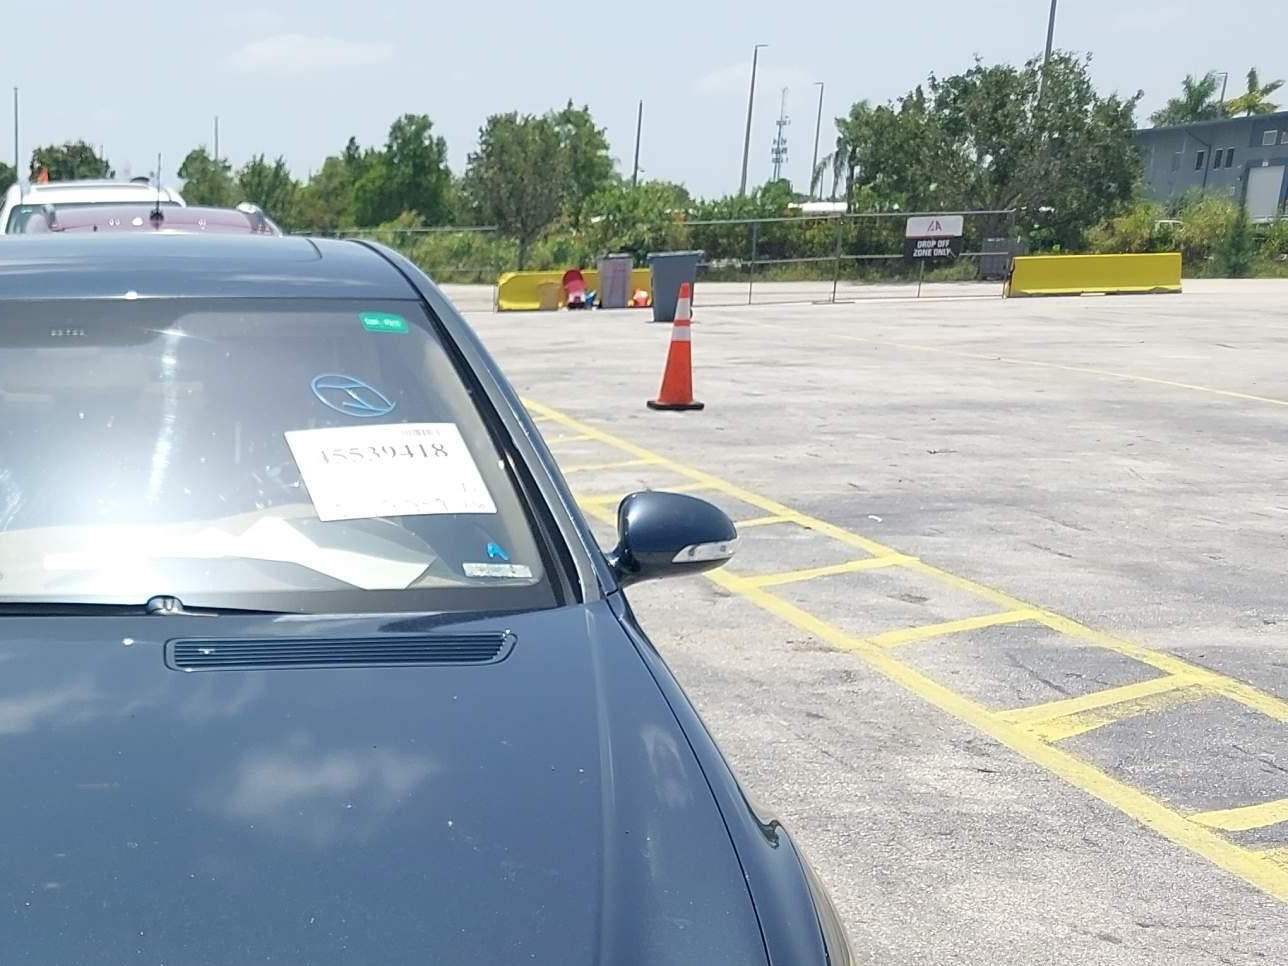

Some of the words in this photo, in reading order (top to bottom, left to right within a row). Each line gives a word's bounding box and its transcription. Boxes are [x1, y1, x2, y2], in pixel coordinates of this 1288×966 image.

[917, 240, 937, 248] DROP
[937, 240, 950, 248] OFF
[913, 249, 933, 257] ZONE
[933, 248, 952, 256] ONLY
